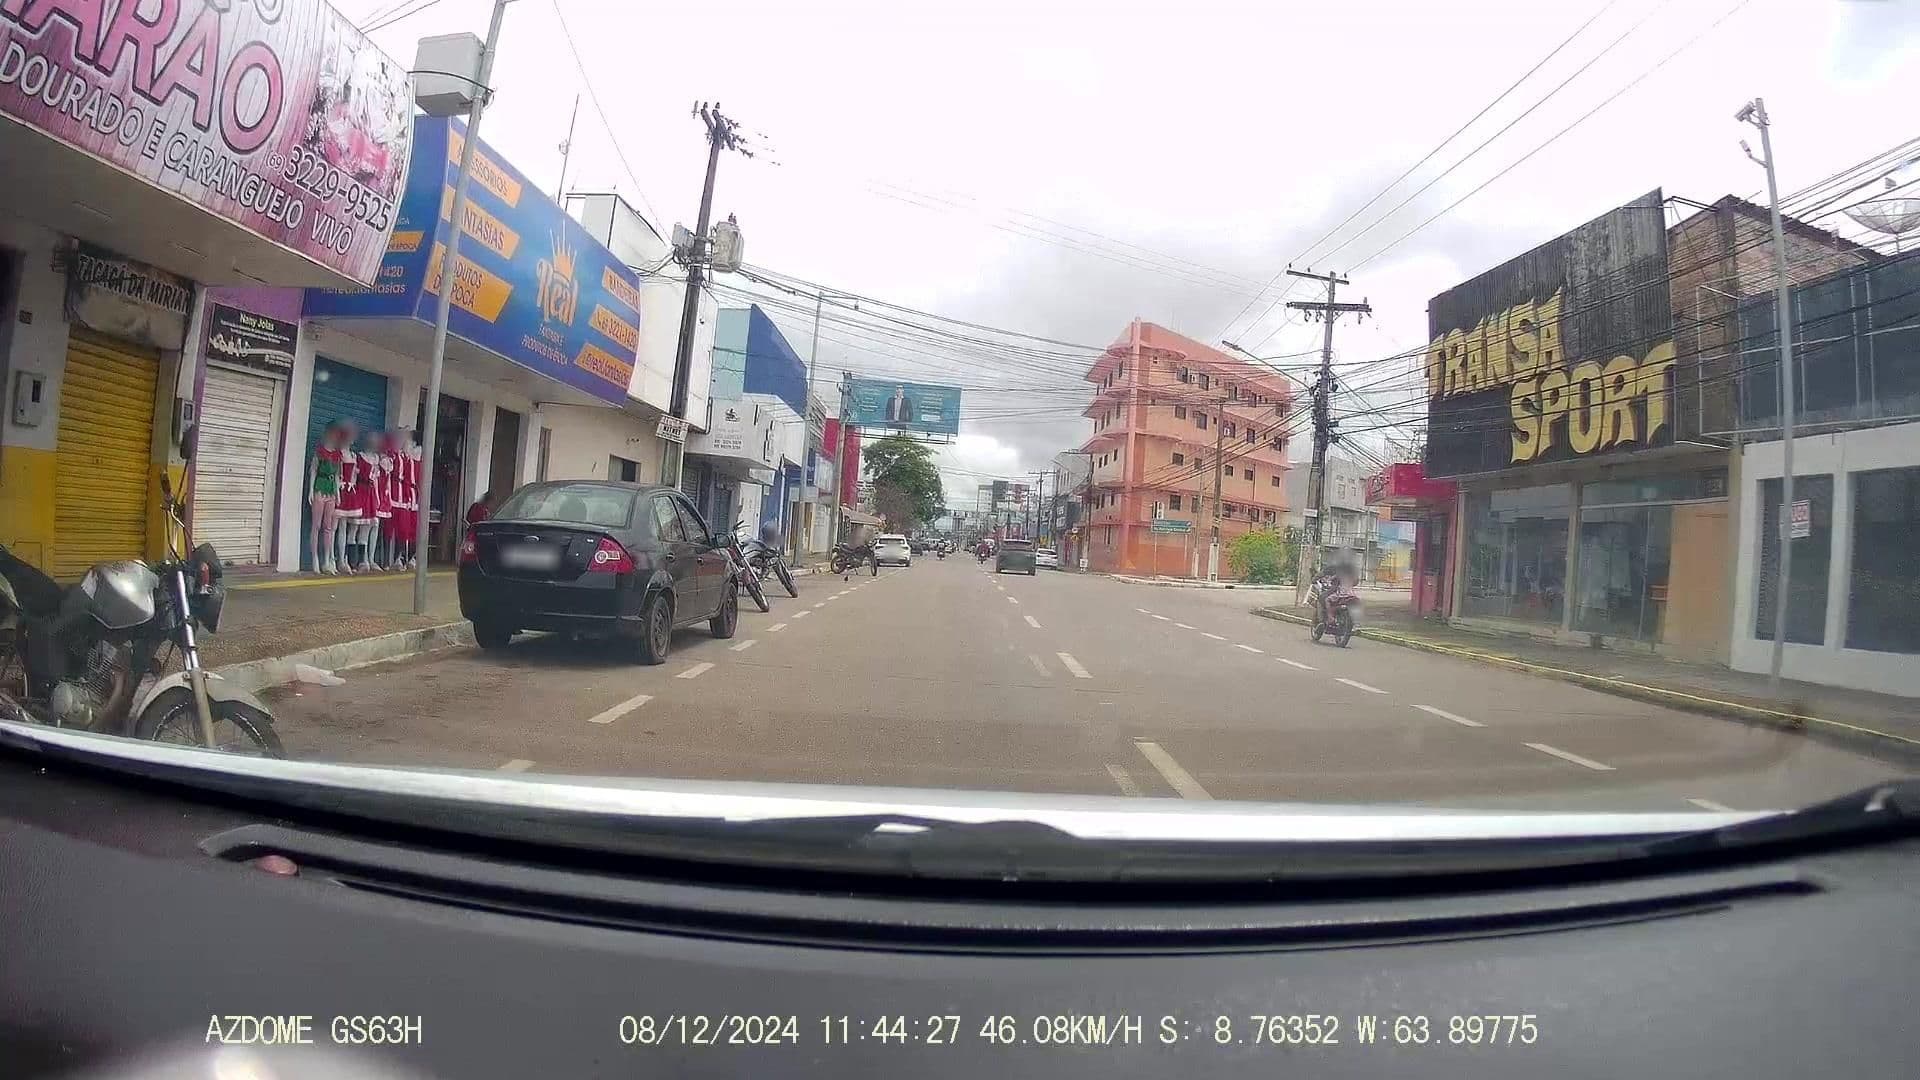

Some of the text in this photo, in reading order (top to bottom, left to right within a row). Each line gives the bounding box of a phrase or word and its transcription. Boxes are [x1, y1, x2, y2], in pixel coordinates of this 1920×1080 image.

[0, 40, 354, 256] DOURADO E CARANGUEJO VIVO
[283, 145, 393, 233] 3229-9525
[462, 206, 505, 251] NTASIAS
[450, 282, 475, 309] POCA
[1424, 285, 1566, 400] TRANSA
[1510, 340, 1679, 465] SPORT
